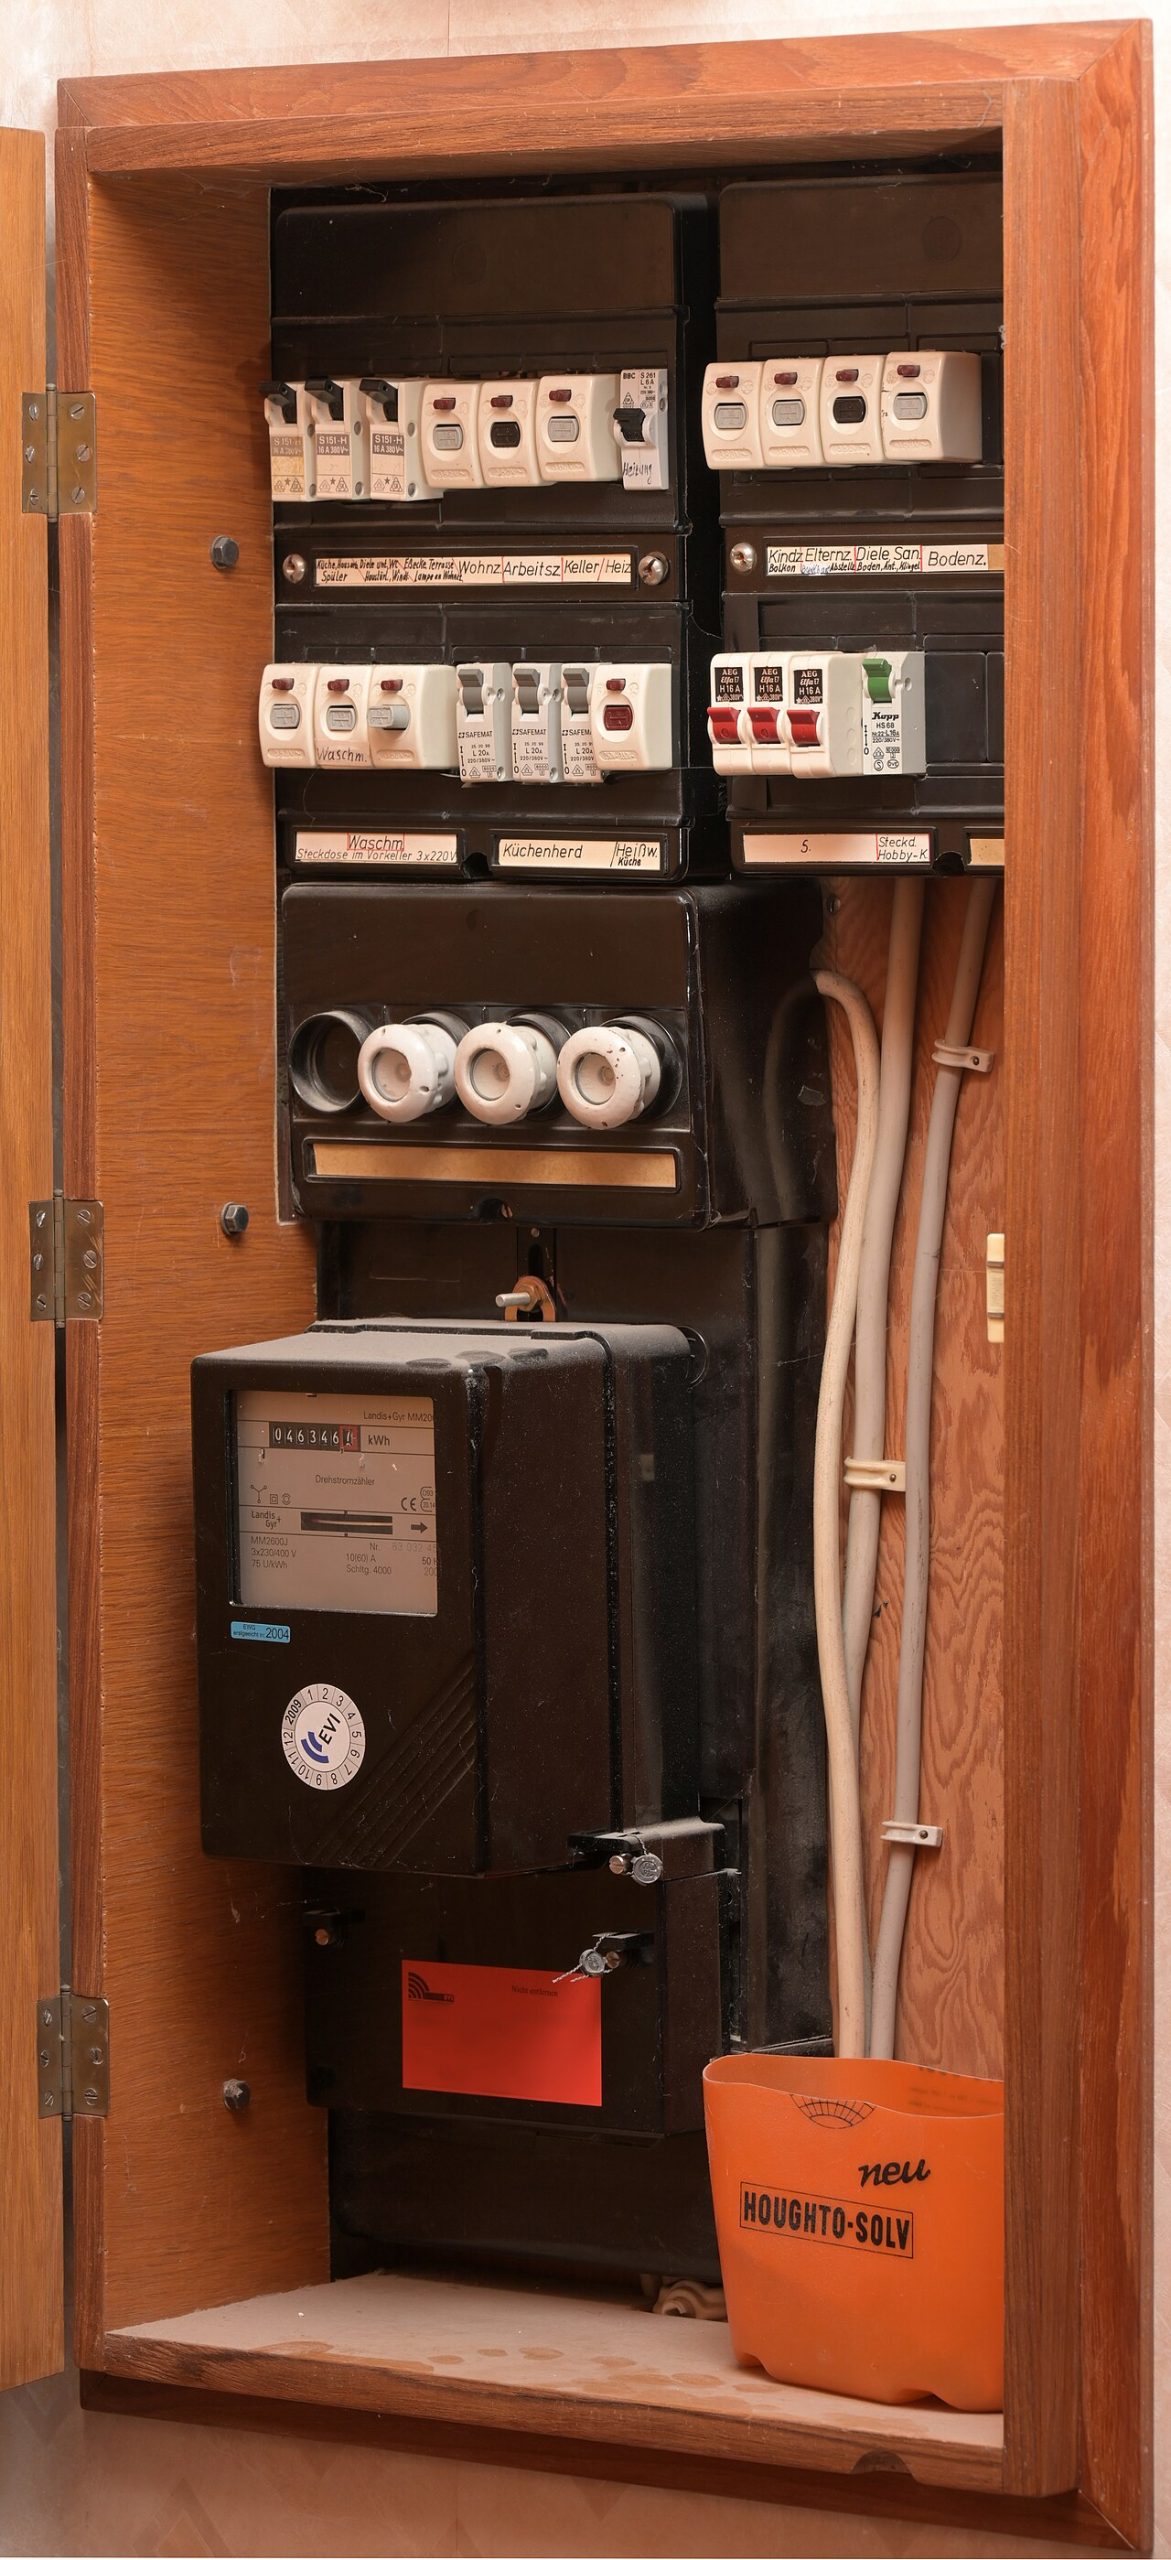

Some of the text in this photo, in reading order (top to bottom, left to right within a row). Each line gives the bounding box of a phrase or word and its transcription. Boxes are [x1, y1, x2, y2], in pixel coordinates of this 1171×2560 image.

[622, 372, 636, 380] BBC
[928, 551, 987, 566] Bodenz.
[321, 570, 348, 583] Spüler
[801, 670, 818, 678] AEG
[871, 711, 900, 721] Kopp
[465, 730, 493, 738] SAFEMAT
[519, 728, 547, 736] SAFEMAT
[568, 728, 592, 736] SAFEM
[316, 747, 368, 763] Waschm.
[878, 836, 917, 848] Steckd.
[297, 848, 348, 860] Steckdose
[352, 849, 363, 860] im
[367, 849, 412, 861] Vorkeller
[502, 842, 658, 859] Küchenherd Heißw.
[618, 856, 642, 867] Küche
[407, 1412, 433, 1423] MM20
[368, 1434, 390, 1446] kWh
[315, 1474, 375, 1486] Drehstromzähler
[251, 1510, 276, 1520] Landis
[265, 1519, 277, 1530] Gyr
[263, 1559, 288, 1569] U/kWh
[369, 1554, 377, 1563] A
[422, 1556, 432, 1566] 50
[373, 1566, 392, 1575] 4000
[265, 1627, 289, 1640] 2004
[318, 1712, 341, 1745] EVI
[283, 1687, 362, 1786] 2009 1 2 3 4 5 6 7 8 9 10 11 12
[858, 2158, 931, 2188] neu
[743, 2190, 910, 2251] HOUGHTO-SOLV
